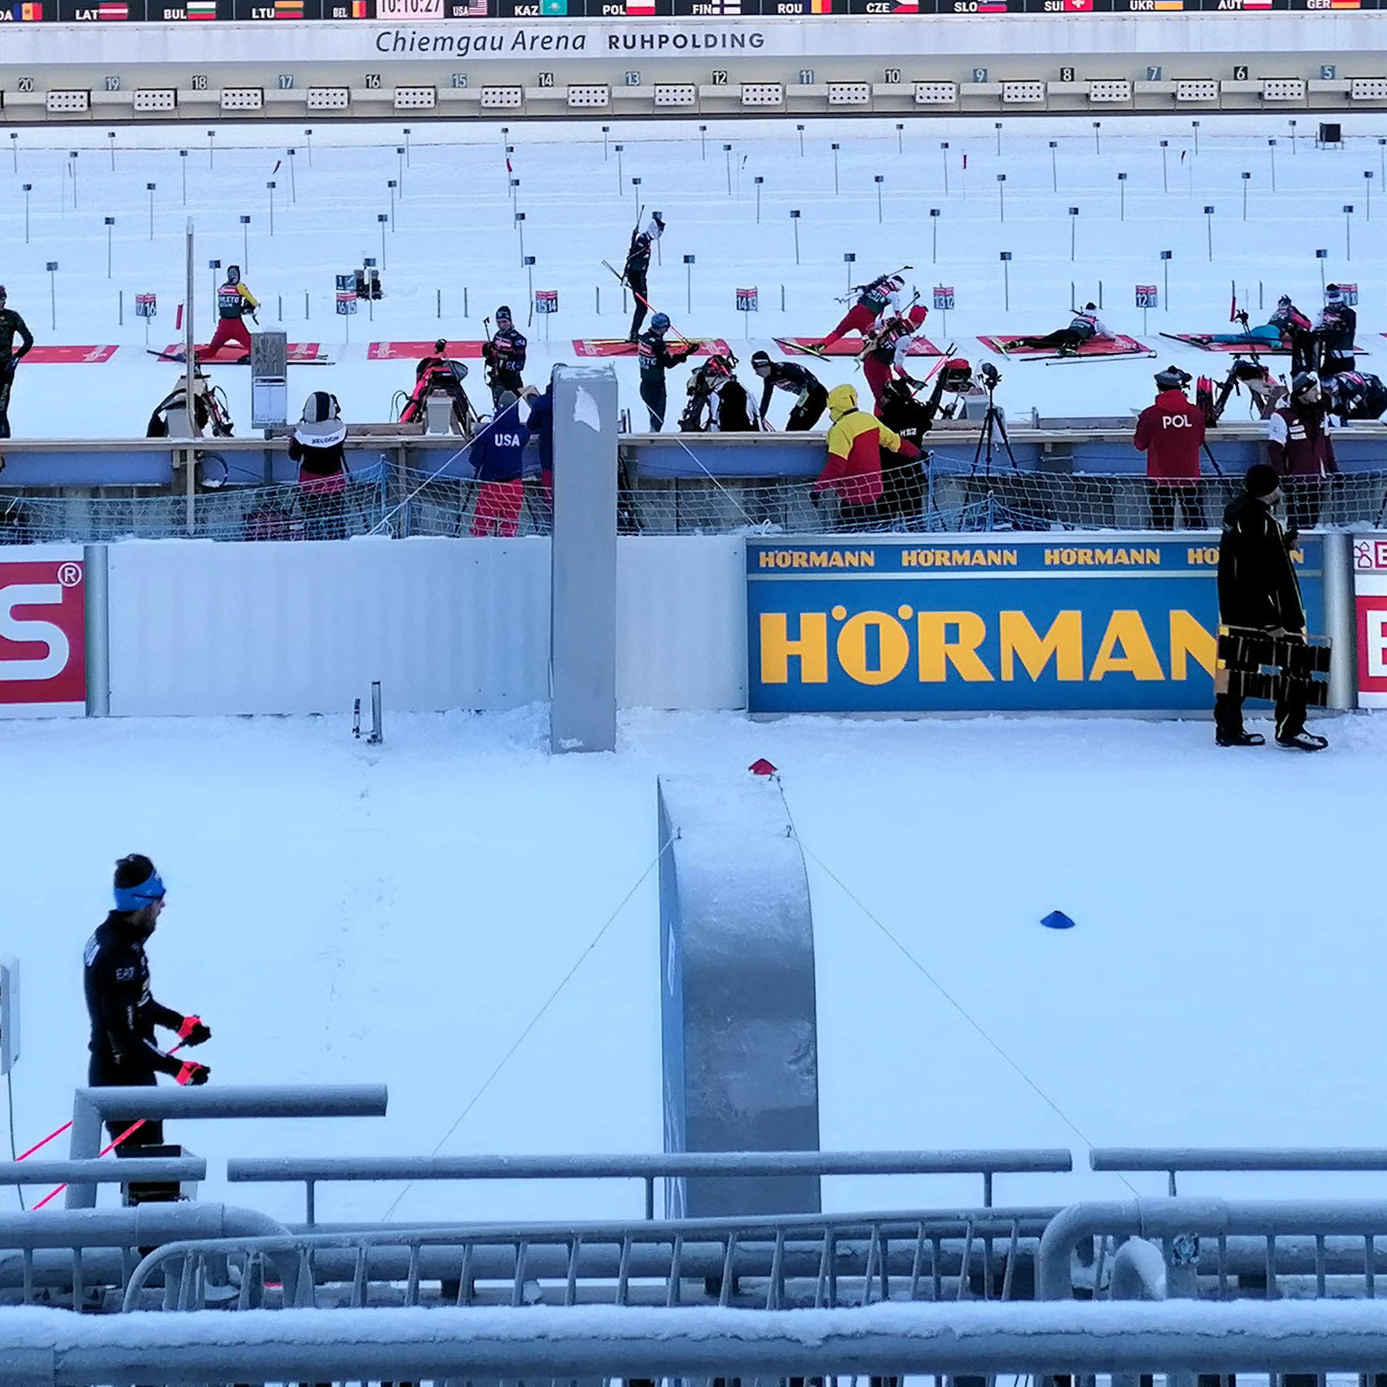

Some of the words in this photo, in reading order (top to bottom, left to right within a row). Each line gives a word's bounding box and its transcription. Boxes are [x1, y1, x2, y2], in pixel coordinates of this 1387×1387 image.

[603, 5, 626, 15] POL
[693, 4, 712, 14] FIN
[778, 4, 802, 13] ROU
[867, 3, 890, 13] CZE
[954, 2, 978, 12] SLO
[1044, 1, 1064, 11] SUI
[1130, 0, 1153, 10] UKR
[1218, 0, 1243, 9] AUT
[76, 11, 99, 20] LAT
[164, 9, 186, 19] BUL
[252, 9, 275, 19] LTU
[333, 8, 347, 18] BEL
[453, 6, 468, 16] USA
[515, 6, 538, 16] KAZ
[376, 30, 503, 57] Chiemgau
[511, 30, 586, 51] Arena
[608, 32, 764, 50] RUHPOLDING
[714, 72, 726, 84] 12
[801, 71, 813, 83] 11
[887, 70, 899, 82] 10
[977, 69, 984, 81] 9
[1063, 68, 1071, 81] 8
[1151, 68, 1157, 80] 7
[1237, 67, 1244, 79] 6
[1324, 66, 1332, 79] 5
[19, 79, 33, 91] 20
[106, 78, 120, 90] 19
[192, 76, 207, 89] 18
[280, 76, 292, 89] 17
[366, 75, 380, 88] 16
[453, 75, 467, 87] 15
[540, 74, 553, 86] 14
[626, 73, 640, 85] 13
[536, 298, 546, 312] 15
[547, 298, 557, 311] 14
[737, 298, 747, 310] 14
[748, 298, 757, 311] 13
[935, 296, 944, 308] 13
[945, 296, 954, 308] 12
[1136, 293, 1147, 307] 12
[145, 303, 156, 315] 16
[1162, 415, 1192, 429] POL
[494, 434, 520, 447] USA
[759, 549, 875, 568] HÖRMANN
[902, 548, 1017, 566] HÖRMANN
[1044, 547, 1160, 565] HÖRMANN
[760, 604, 1218, 686] HÖRMAN
